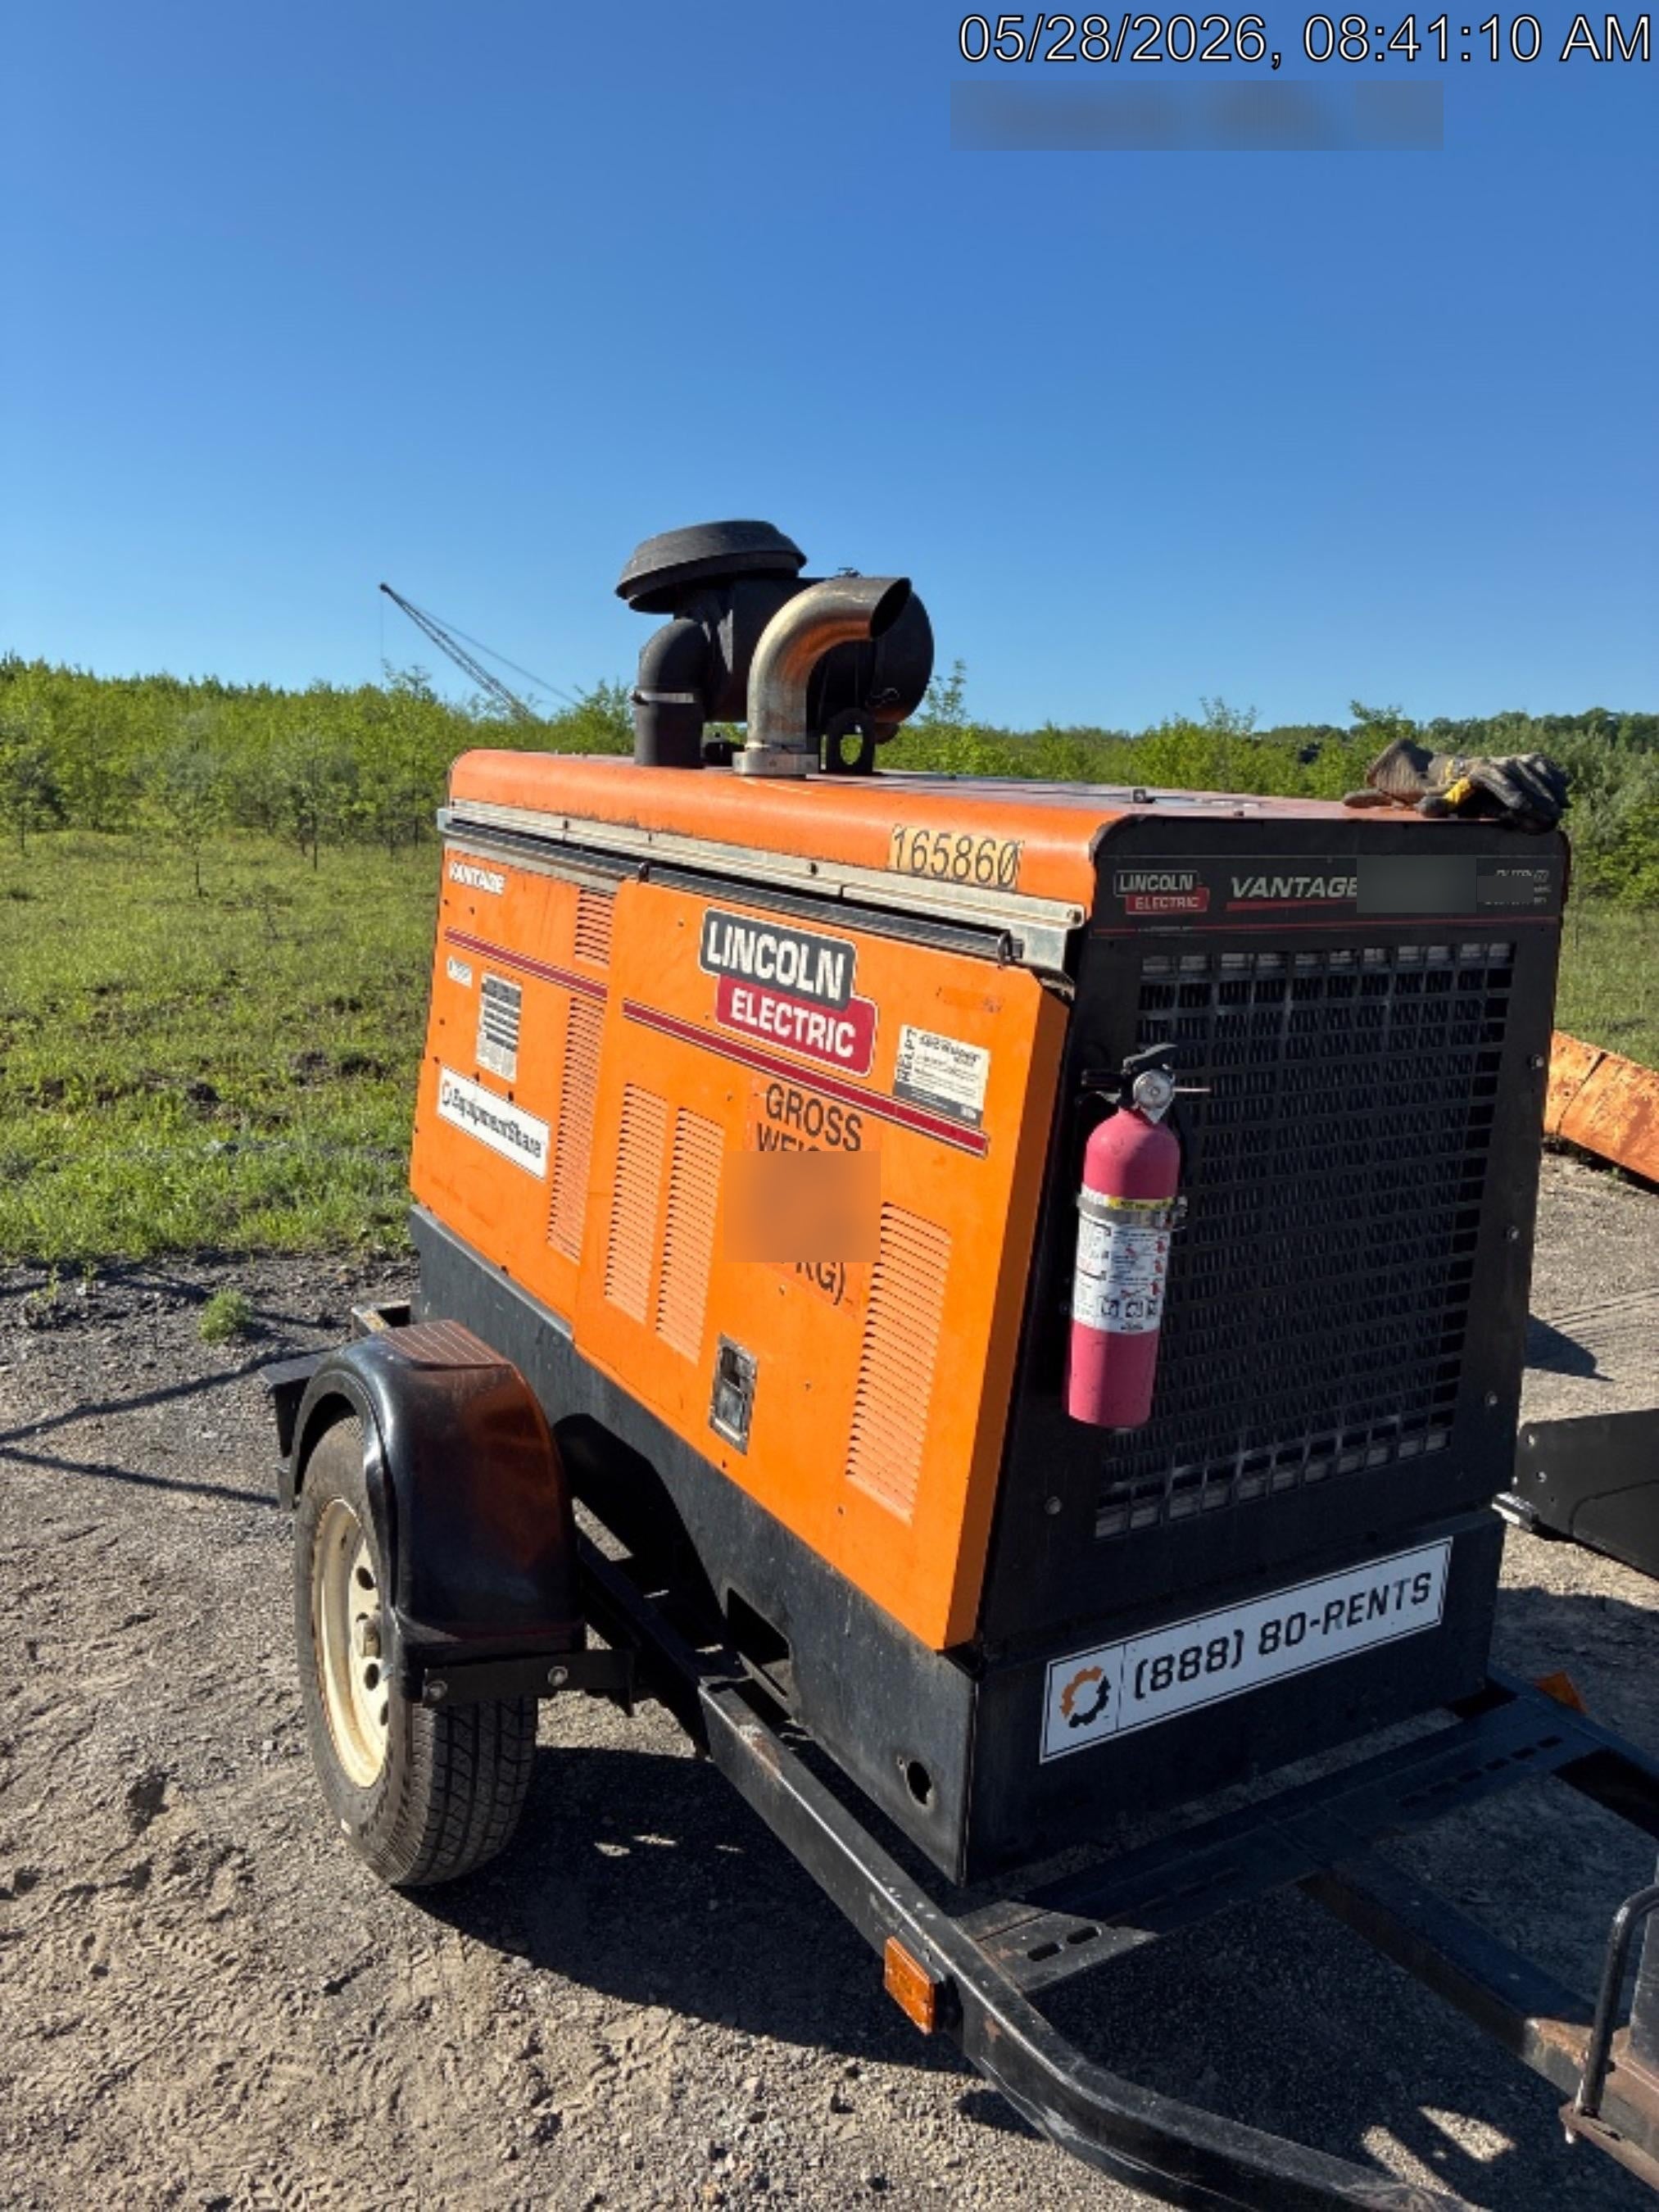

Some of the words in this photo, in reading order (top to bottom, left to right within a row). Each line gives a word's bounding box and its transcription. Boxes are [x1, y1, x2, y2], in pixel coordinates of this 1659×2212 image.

[893, 829, 1018, 886] 165860
[1118, 873, 1193, 892] LINCOLN
[1134, 896, 1199, 910] ELECTRIC
[705, 920, 846, 1001] LINCOLN
[730, 987, 856, 1058] ELECTRIC
[765, 1083, 863, 1152] GROSS
[1135, 1630, 1244, 1699] (888)
[1258, 1572, 1432, 1656] 80-RENTS
